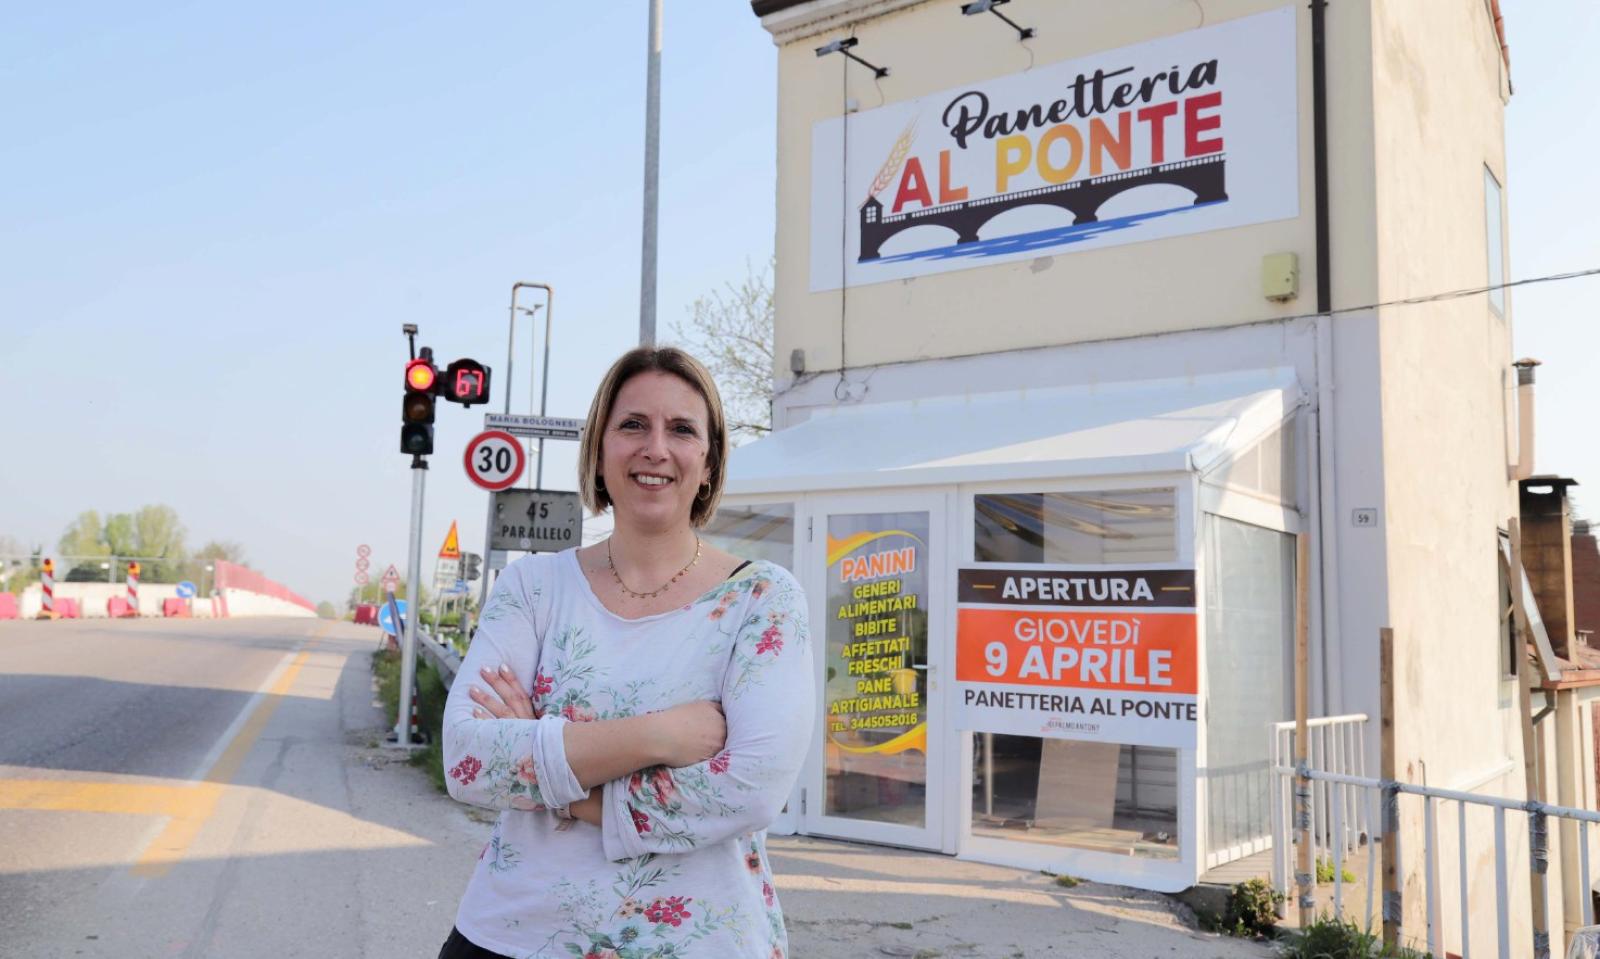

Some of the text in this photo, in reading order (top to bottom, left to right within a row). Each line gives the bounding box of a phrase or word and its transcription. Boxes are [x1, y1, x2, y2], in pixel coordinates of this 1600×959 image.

[942, 58, 1219, 149] Panetteria
[891, 90, 1224, 213] AL PONTE
[455, 369, 483, 396] 67
[489, 416, 577, 427] MARIA BOLOGNESI
[478, 446, 512, 474] 30
[1358, 514, 1369, 523] 59
[502, 524, 572, 541] PARALLELO
[841, 546, 916, 582] PANINI
[853, 580, 901, 599] GENERI
[1002, 576, 1154, 601] APERTURA
[838, 595, 917, 619] ALIMENTARI
[855, 618, 897, 637] BIBITE
[1014, 617, 1141, 645] GIOVEDÌ
[841, 637, 911, 659] AFFETTATI
[848, 655, 903, 675] FRESCHI
[984, 641, 1172, 687] 9 APRILE
[857, 678, 892, 694] PANE
[831, 693, 919, 715] ARTIGIANALE
[964, 689, 1197, 721] PANETTERIA AL PONTE
[851, 711, 918, 731] 3445052016
